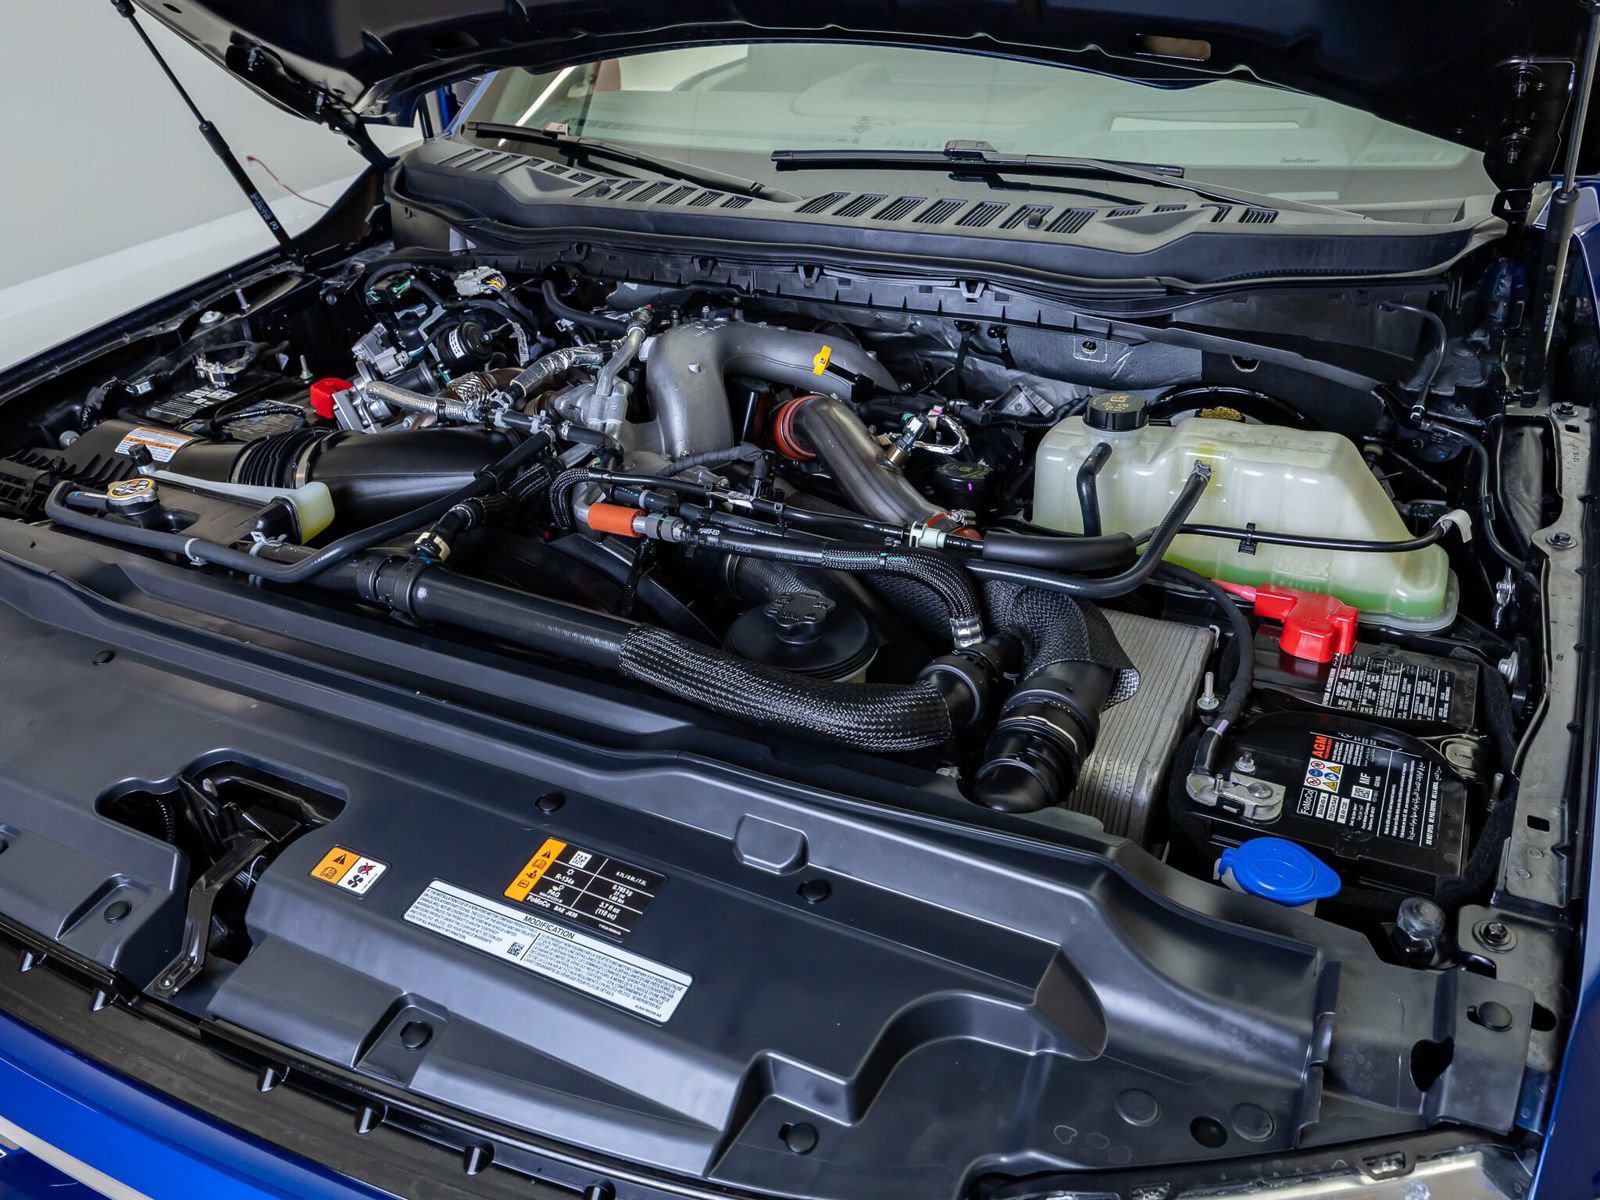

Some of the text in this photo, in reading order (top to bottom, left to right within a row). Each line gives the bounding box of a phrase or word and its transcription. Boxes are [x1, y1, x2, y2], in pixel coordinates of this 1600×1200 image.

[1311, 735, 1327, 758] AGM
[1359, 772, 1370, 785] MF
[1300, 788, 1314, 814] FoMoCo
[554, 873, 576, 884] R-134a
[547, 888, 561, 898] PAG
[526, 895, 551, 908] FoMoCo
[553, 905, 565, 913] SAE
[599, 901, 609, 909] 3.7
[522, 915, 575, 939] MODIFICATION
